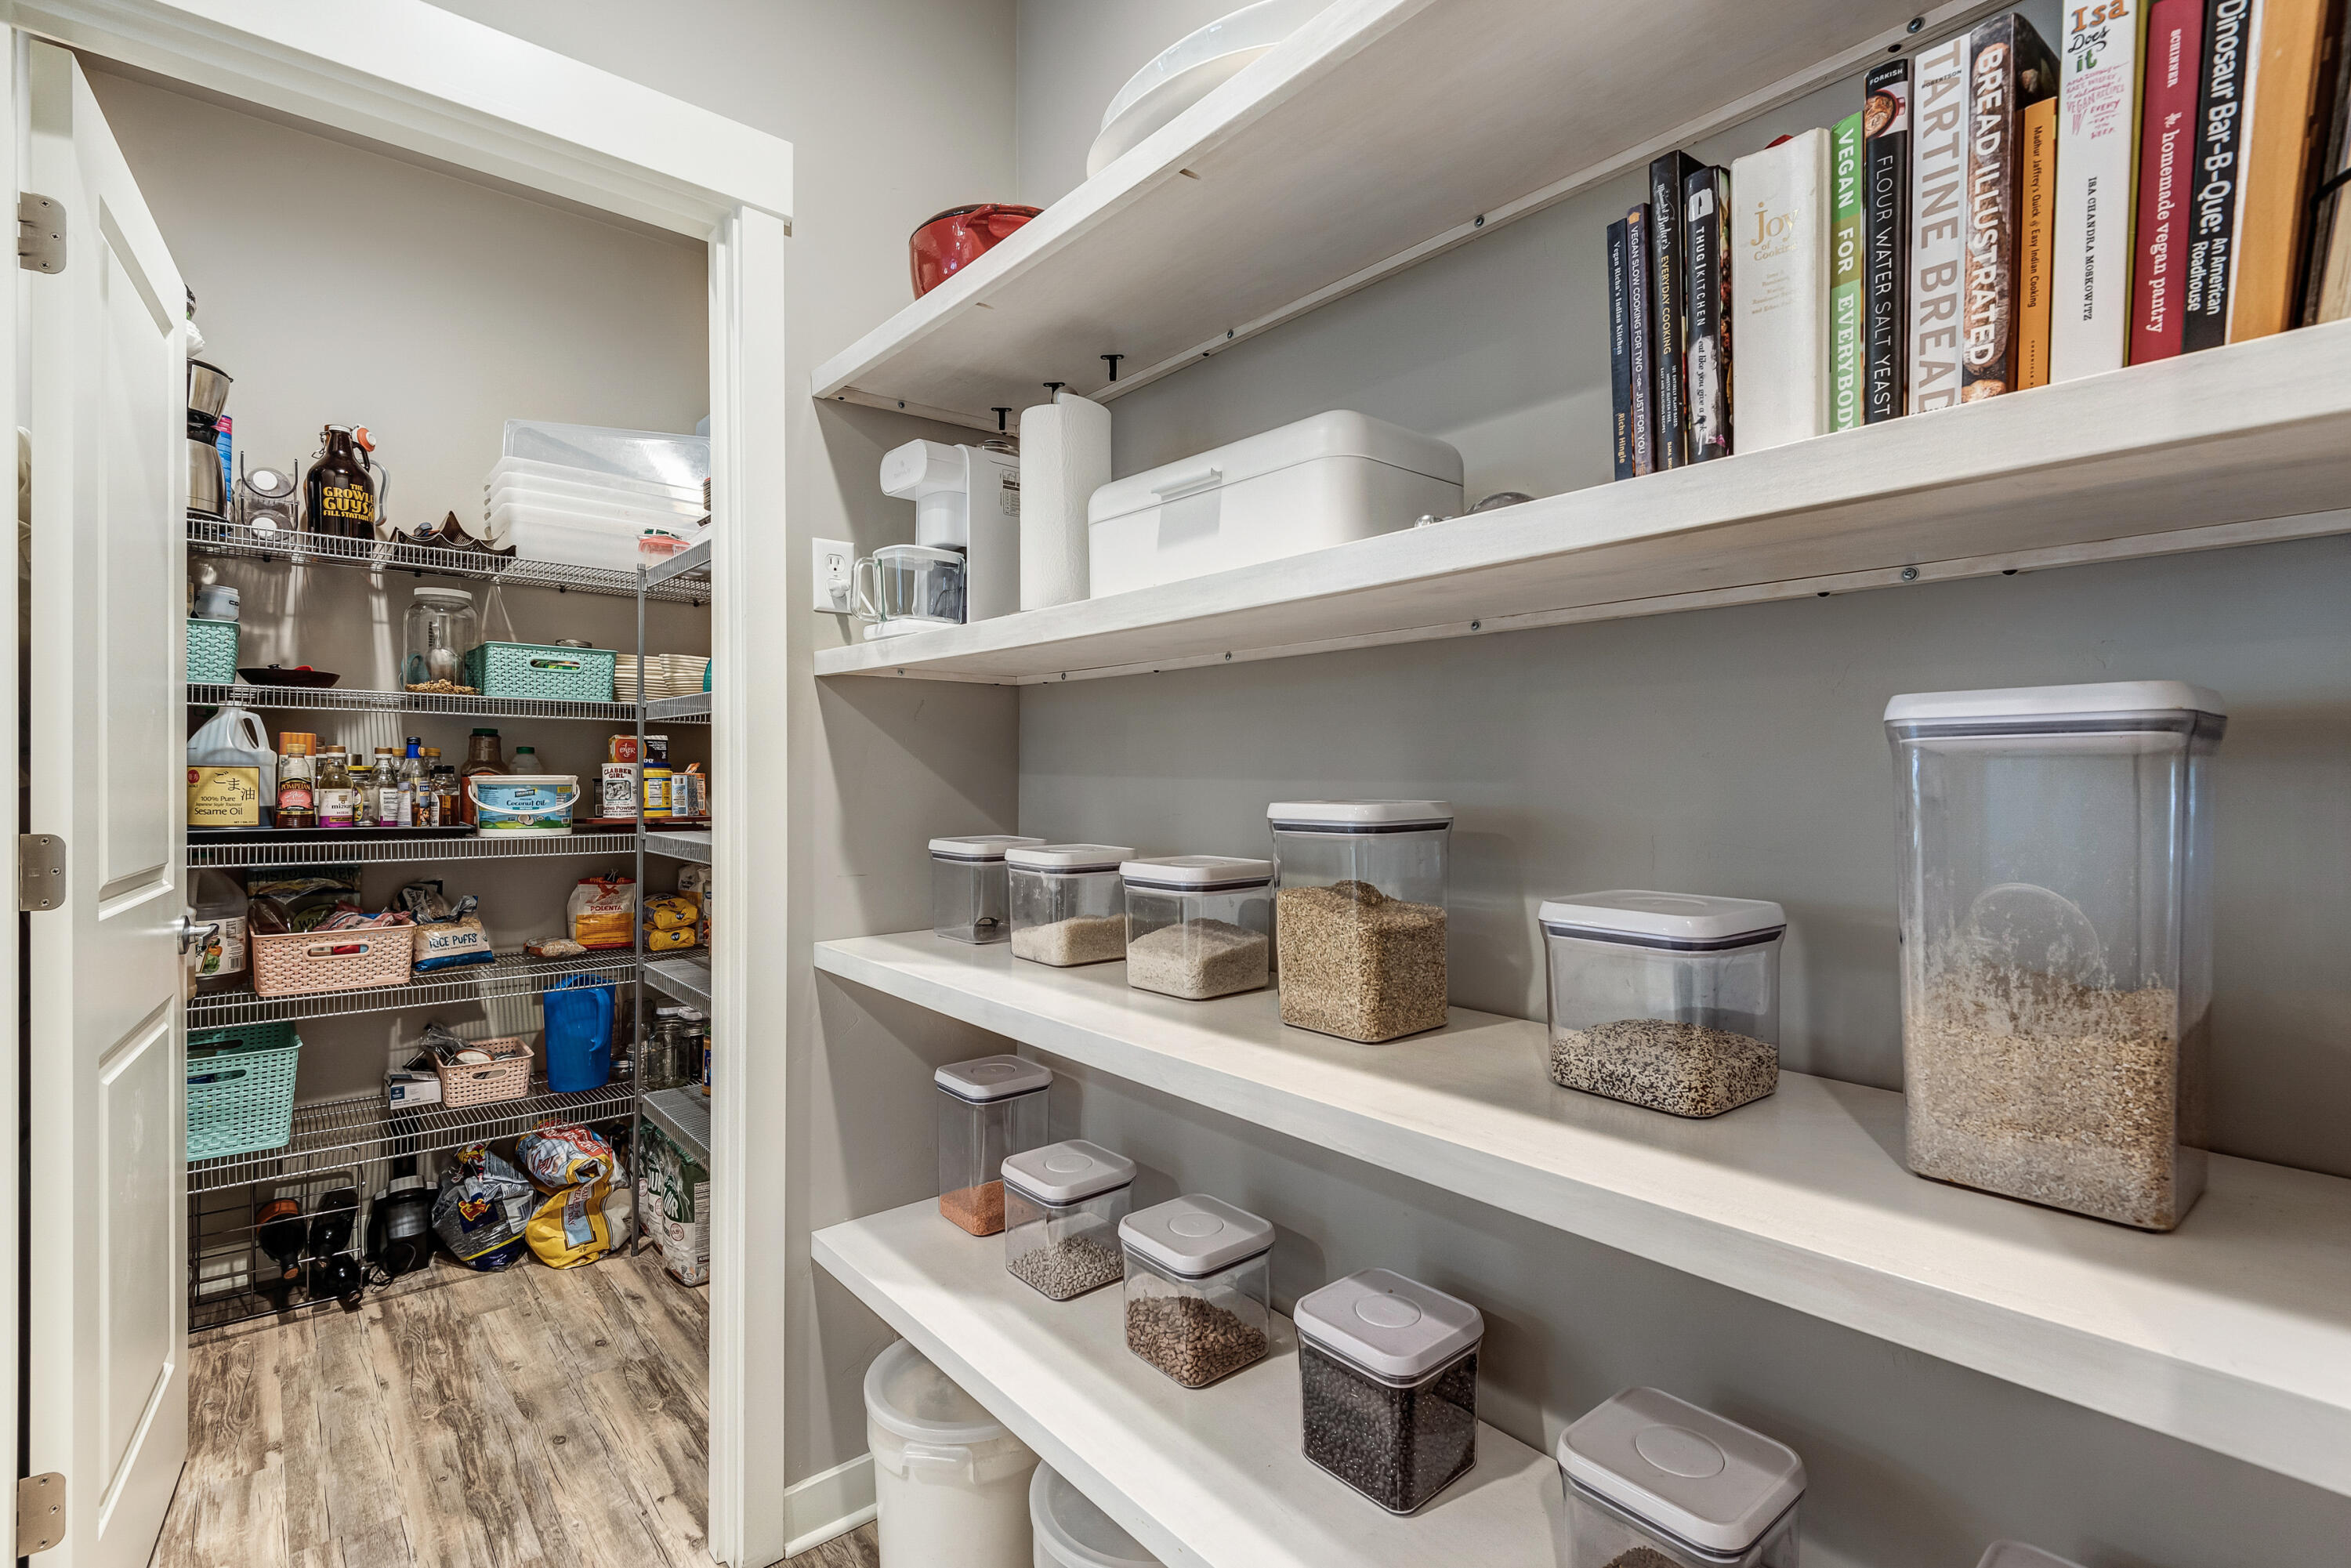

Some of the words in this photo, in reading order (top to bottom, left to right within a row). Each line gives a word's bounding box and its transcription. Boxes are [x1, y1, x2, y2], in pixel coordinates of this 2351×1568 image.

[2070, 0, 2130, 34] Isa
[2067, 26, 2110, 55] Does
[2210, 0, 2248, 99] Dinosaur
[1869, 68, 1904, 86] FORKISH
[2076, 49, 2097, 73] it
[1922, 69, 1962, 89] ROBERTSON
[1975, 49, 2003, 156] BREAD
[1921, 39, 1962, 249] TARTINE
[2032, 125, 2043, 157] Madhur
[1838, 128, 1854, 208] VEGAN
[2030, 159, 2042, 193] Jaffrey's
[2157, 129, 2180, 220] homemade
[2197, 101, 2238, 235] Bar-B-Que:
[1876, 155, 1893, 223] FLOUR
[2088, 176, 2097, 195] ISA
[2031, 194, 2041, 218] Quick
[2029, 229, 2041, 248] Easy
[2086, 196, 2097, 252] CHANDRA
[1631, 226, 1639, 259] VEGAN
[1696, 226, 1705, 262] THUG
[1762, 240, 1771, 251] of
[1838, 226, 1854, 275] FOR
[2150, 223, 2168, 275] vegan
[2212, 237, 2228, 255] An
[1632, 259, 1640, 287] SLOW
[1875, 226, 1893, 296] WATER
[1969, 162, 2000, 365] ILLUSTRATED
[2030, 249, 2041, 273] Indian
[2187, 241, 2209, 311] Roadhouse
[1661, 255, 1670, 305] EVERYDAY
[2028, 276, 2040, 307] Cooking
[2083, 255, 2095, 321] MOSKOWITZ
[2206, 256, 2227, 315] American
[1614, 299, 1623, 324] Indian
[1632, 288, 1642, 328] COOKING
[1697, 270, 1706, 326] KITCHEN
[2145, 277, 2166, 333] pantry
[1662, 306, 1672, 355] COOKING
[1875, 301, 1892, 346] SALT
[1635, 350, 1643, 372] TWO
[1697, 371, 1706, 387] you
[1874, 354, 1891, 415] YEAST
[1636, 392, 1644, 413] JUST
[1697, 389, 1706, 405] give
[1636, 415, 1645, 433] FOR
[1697, 414, 1707, 433] fck
[1618, 437, 1627, 464] Hingle
[1637, 434, 1646, 454] YOU
[323, 497, 368, 515] GUYS
[341, 511, 369, 522] STATION
[281, 782, 311, 791] POMPEIAN
